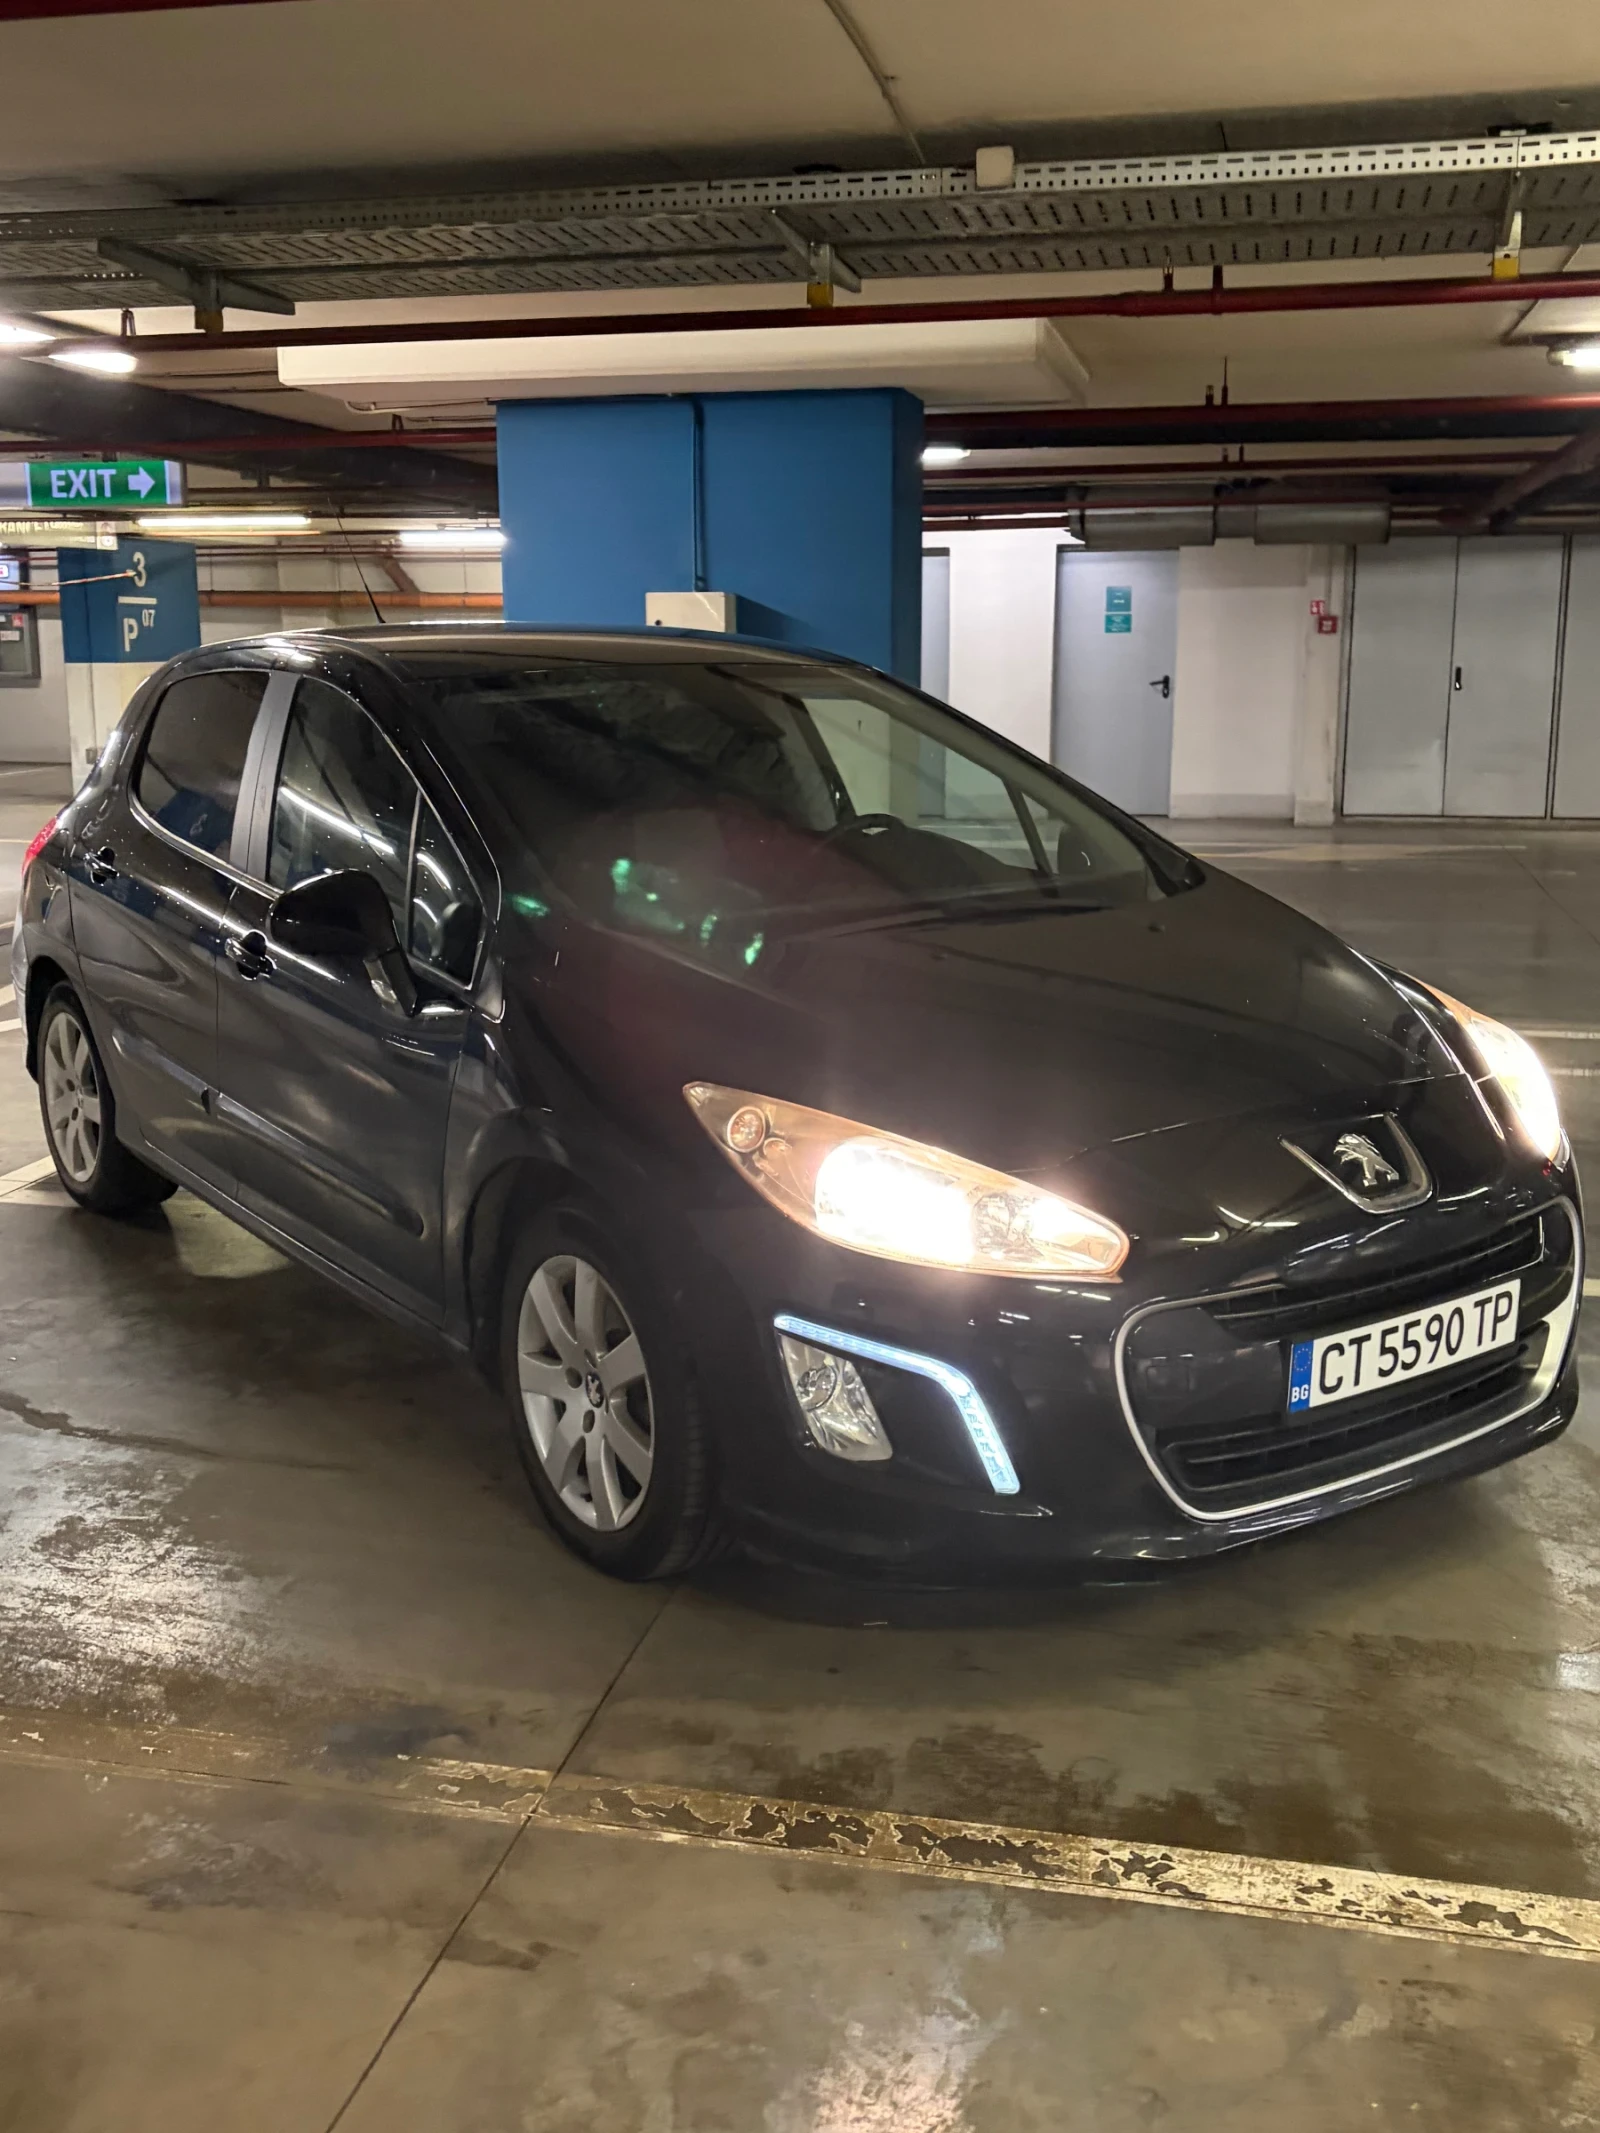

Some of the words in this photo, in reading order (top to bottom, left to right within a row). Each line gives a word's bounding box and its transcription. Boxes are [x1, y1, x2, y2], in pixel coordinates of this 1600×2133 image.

[50, 468, 117, 499] EXIT
[132, 551, 147, 587] 3
[1319, 1333, 1372, 1396] CT
[1377, 1306, 1465, 1378] 5590
[1474, 1290, 1514, 1347] TP
[1291, 1384, 1310, 1403] BG
